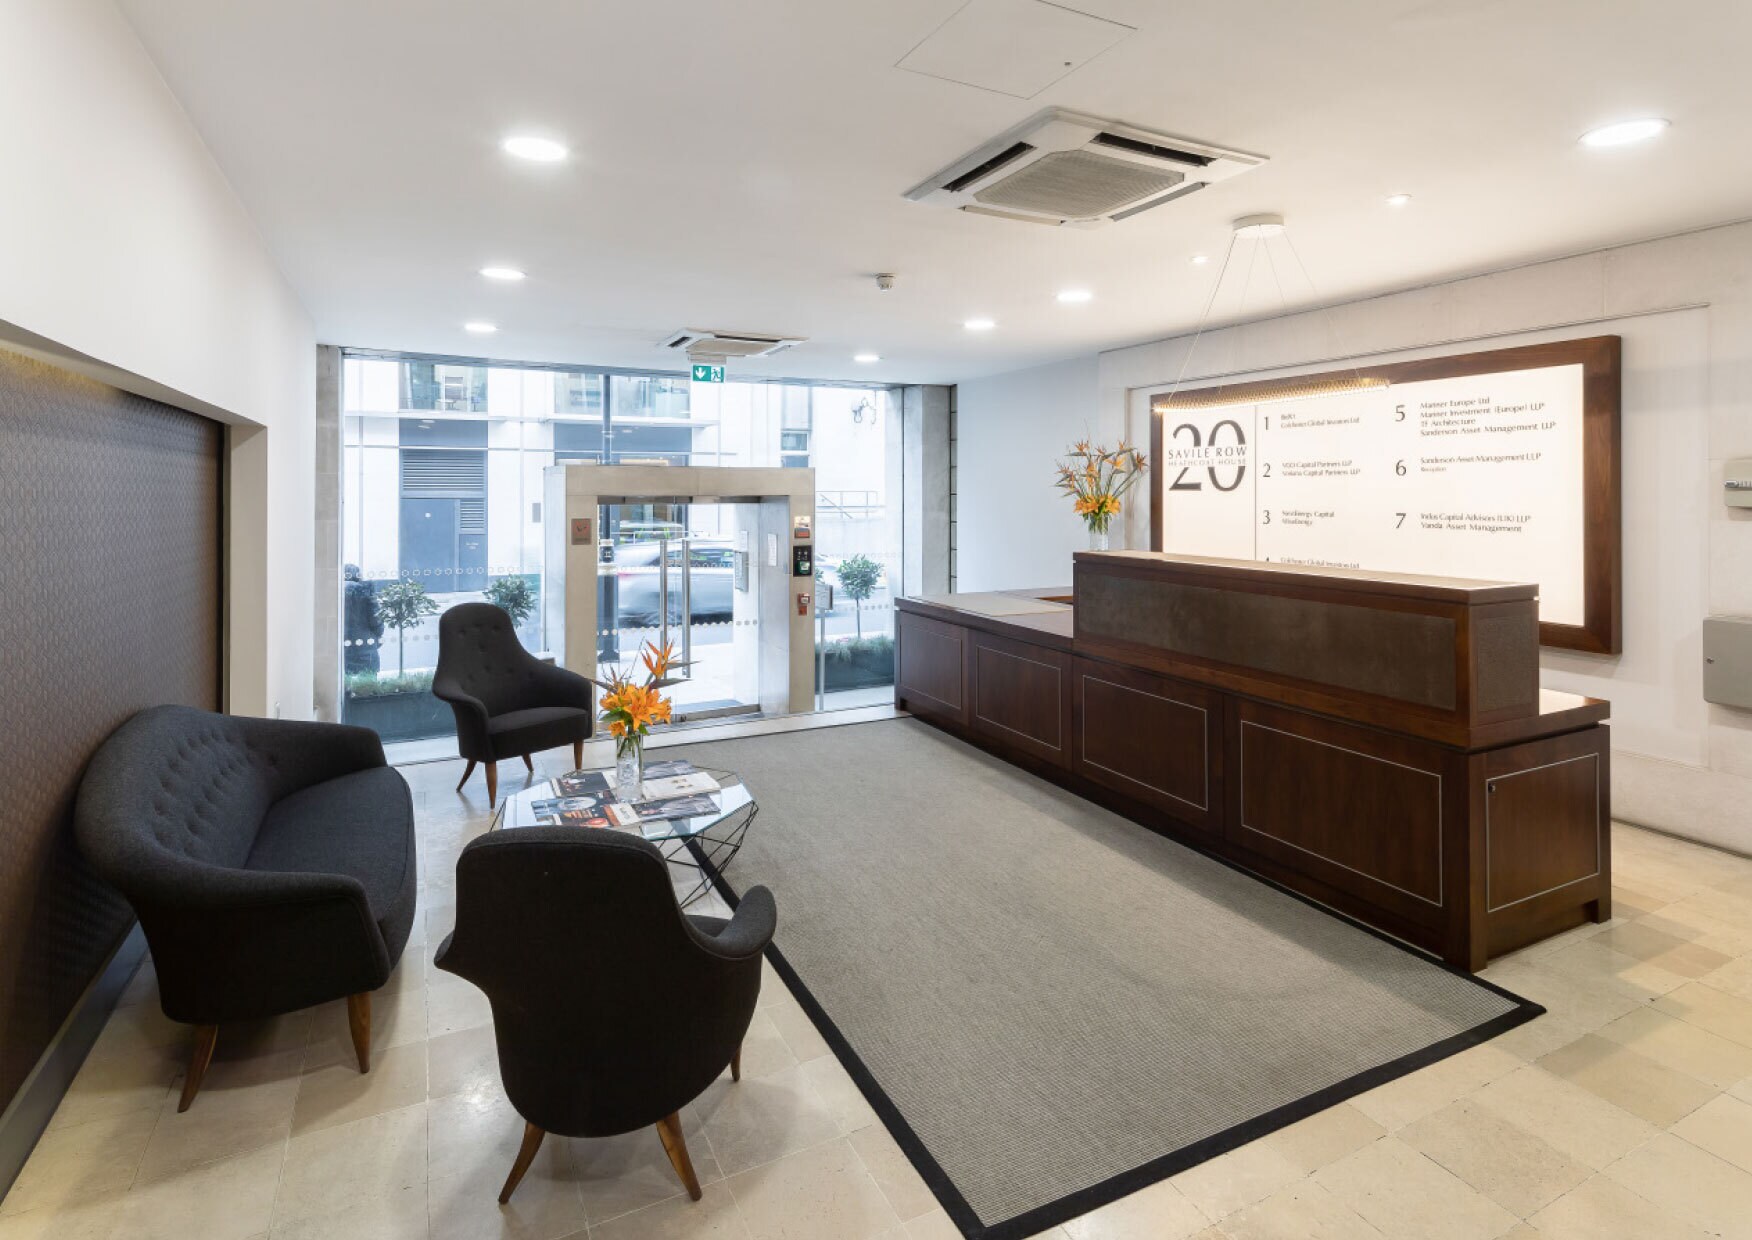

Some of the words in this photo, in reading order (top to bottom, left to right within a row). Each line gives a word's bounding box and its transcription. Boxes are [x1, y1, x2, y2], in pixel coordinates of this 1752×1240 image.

[1450, 399, 1476, 408] Europe
[1477, 396, 1490, 404] Ltd
[1450, 407, 1490, 416] Investment
[1530, 402, 1545, 411] LLP
[1395, 404, 1406, 422] 5
[1264, 415, 1270, 431] 1
[1420, 428, 1458, 437] Sanderson
[1461, 427, 1481, 435] Asset
[1484, 424, 1538, 435] Management
[1541, 421, 1557, 430] LLP
[1168, 447, 1210, 459] SAVILE
[1215, 446, 1247, 457] ROW
[1169, 419, 1246, 491] 20
[1476, 453, 1525, 463] Management
[1526, 452, 1541, 461] LLP
[1262, 462, 1271, 477] 2
[1296, 460, 1316, 469] Capital
[1395, 459, 1407, 476] 6
[1303, 469, 1323, 477] Capital
[1262, 510, 1271, 525] 3
[1314, 511, 1335, 519] Capital
[1395, 513, 1407, 529] 7
[1439, 512, 1463, 522] Capital
[1465, 513, 1496, 521] Advisors
[1516, 515, 1531, 523] LLP
[1470, 524, 1522, 534] Management
